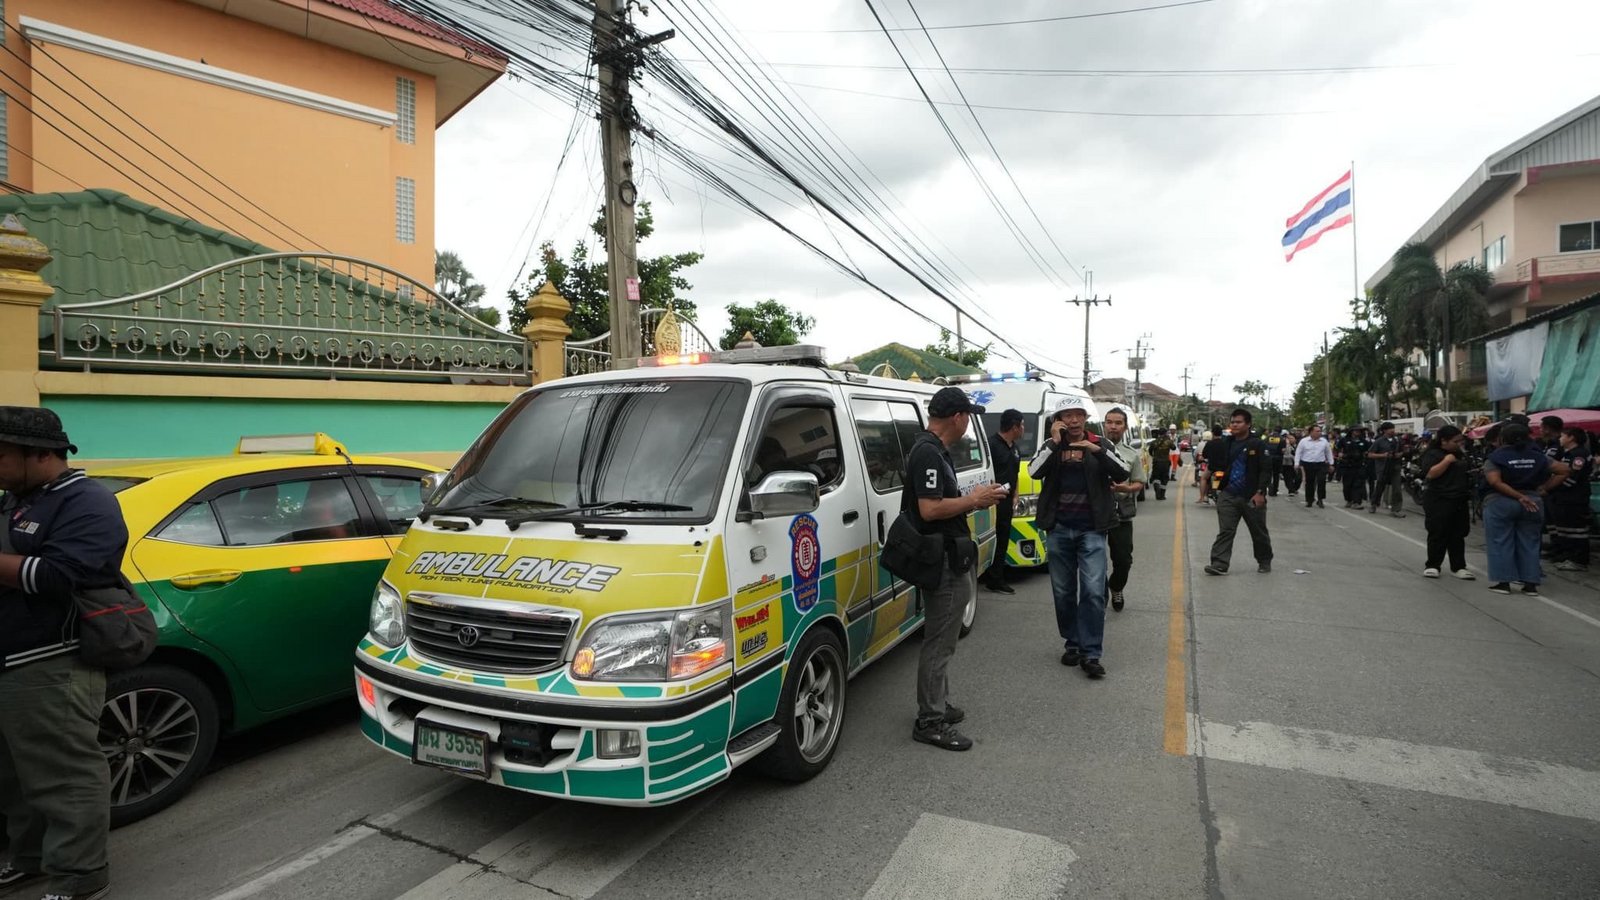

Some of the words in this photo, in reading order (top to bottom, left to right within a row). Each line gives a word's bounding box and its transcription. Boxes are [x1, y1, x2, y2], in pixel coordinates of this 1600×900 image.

[925, 468, 938, 489] 3
[791, 516, 817, 537] RESCUE
[405, 551, 622, 592] AMBULANCE
[467, 577, 493, 585] TUNG
[494, 580, 574, 595] FOUNDATION
[445, 732, 482, 756] 3555
